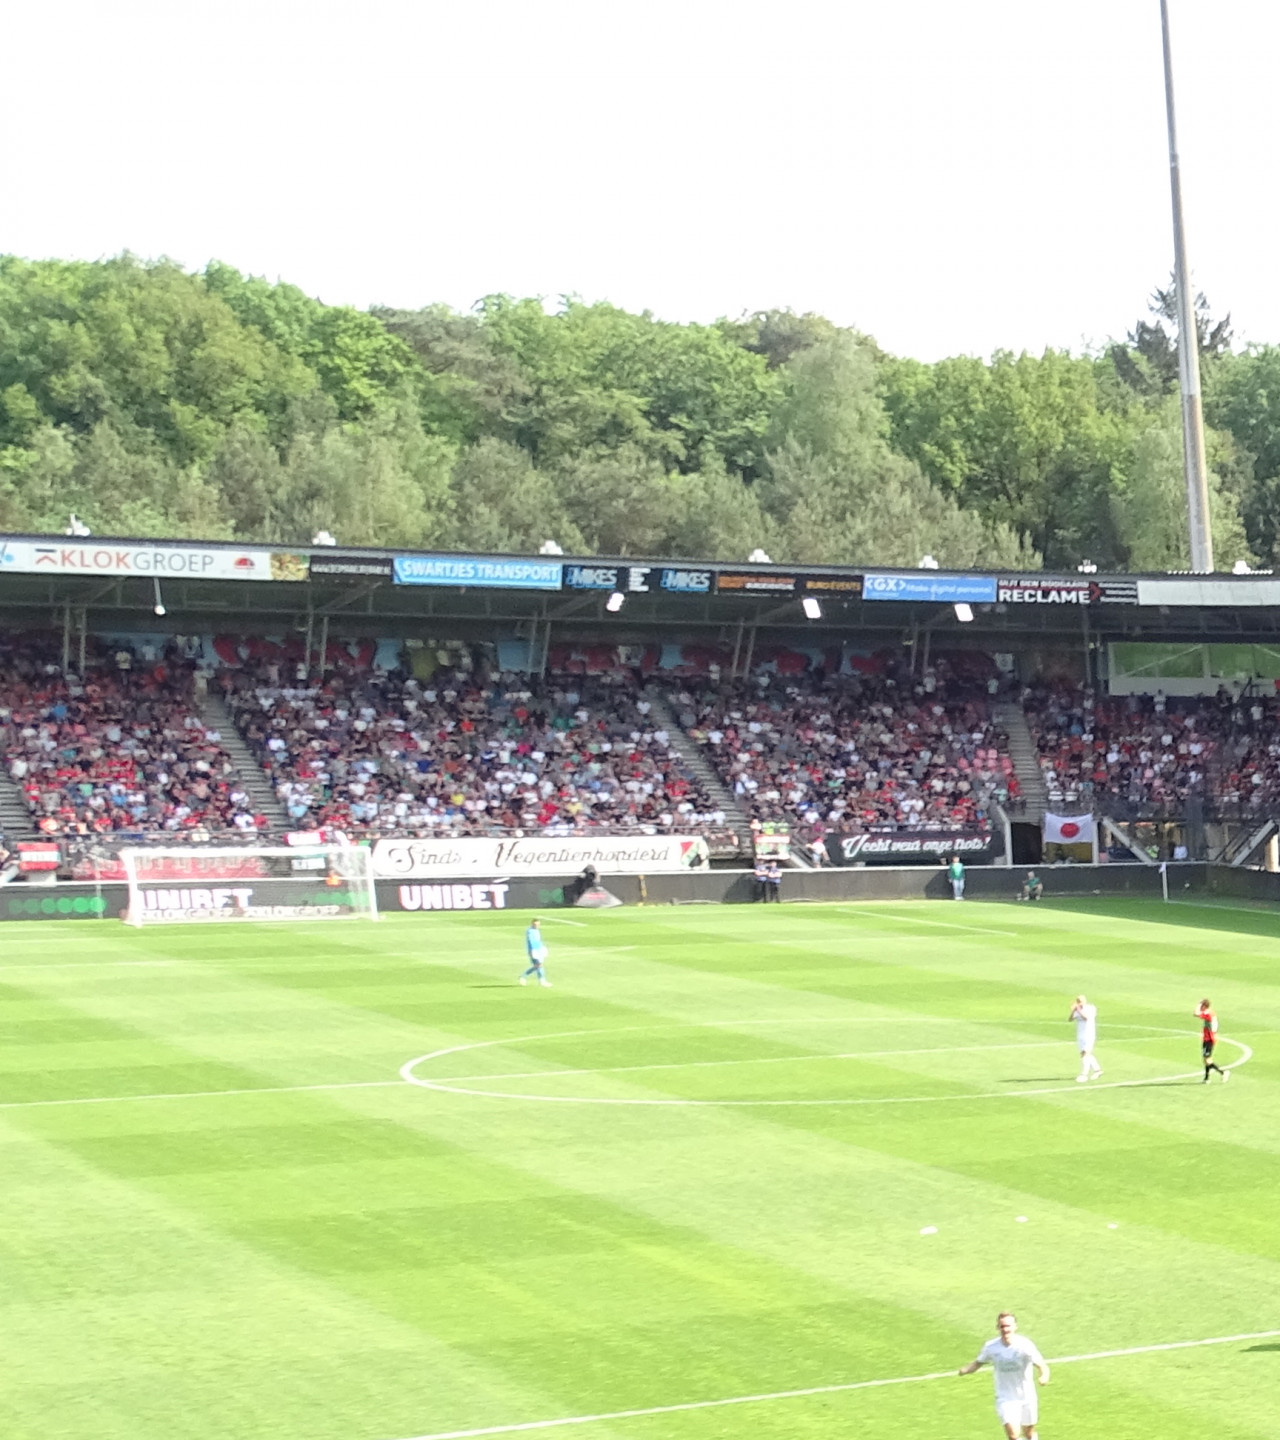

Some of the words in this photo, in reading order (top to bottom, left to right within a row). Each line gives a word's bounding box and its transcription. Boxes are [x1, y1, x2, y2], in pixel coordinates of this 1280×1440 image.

[60, 550, 214, 572] KLOKGROEP
[404, 562, 474, 578] SWARTJES
[478, 564, 559, 581] TRANSPORT
[1000, 589, 1091, 604] RECLAME
[400, 883, 508, 910] UNIBET
